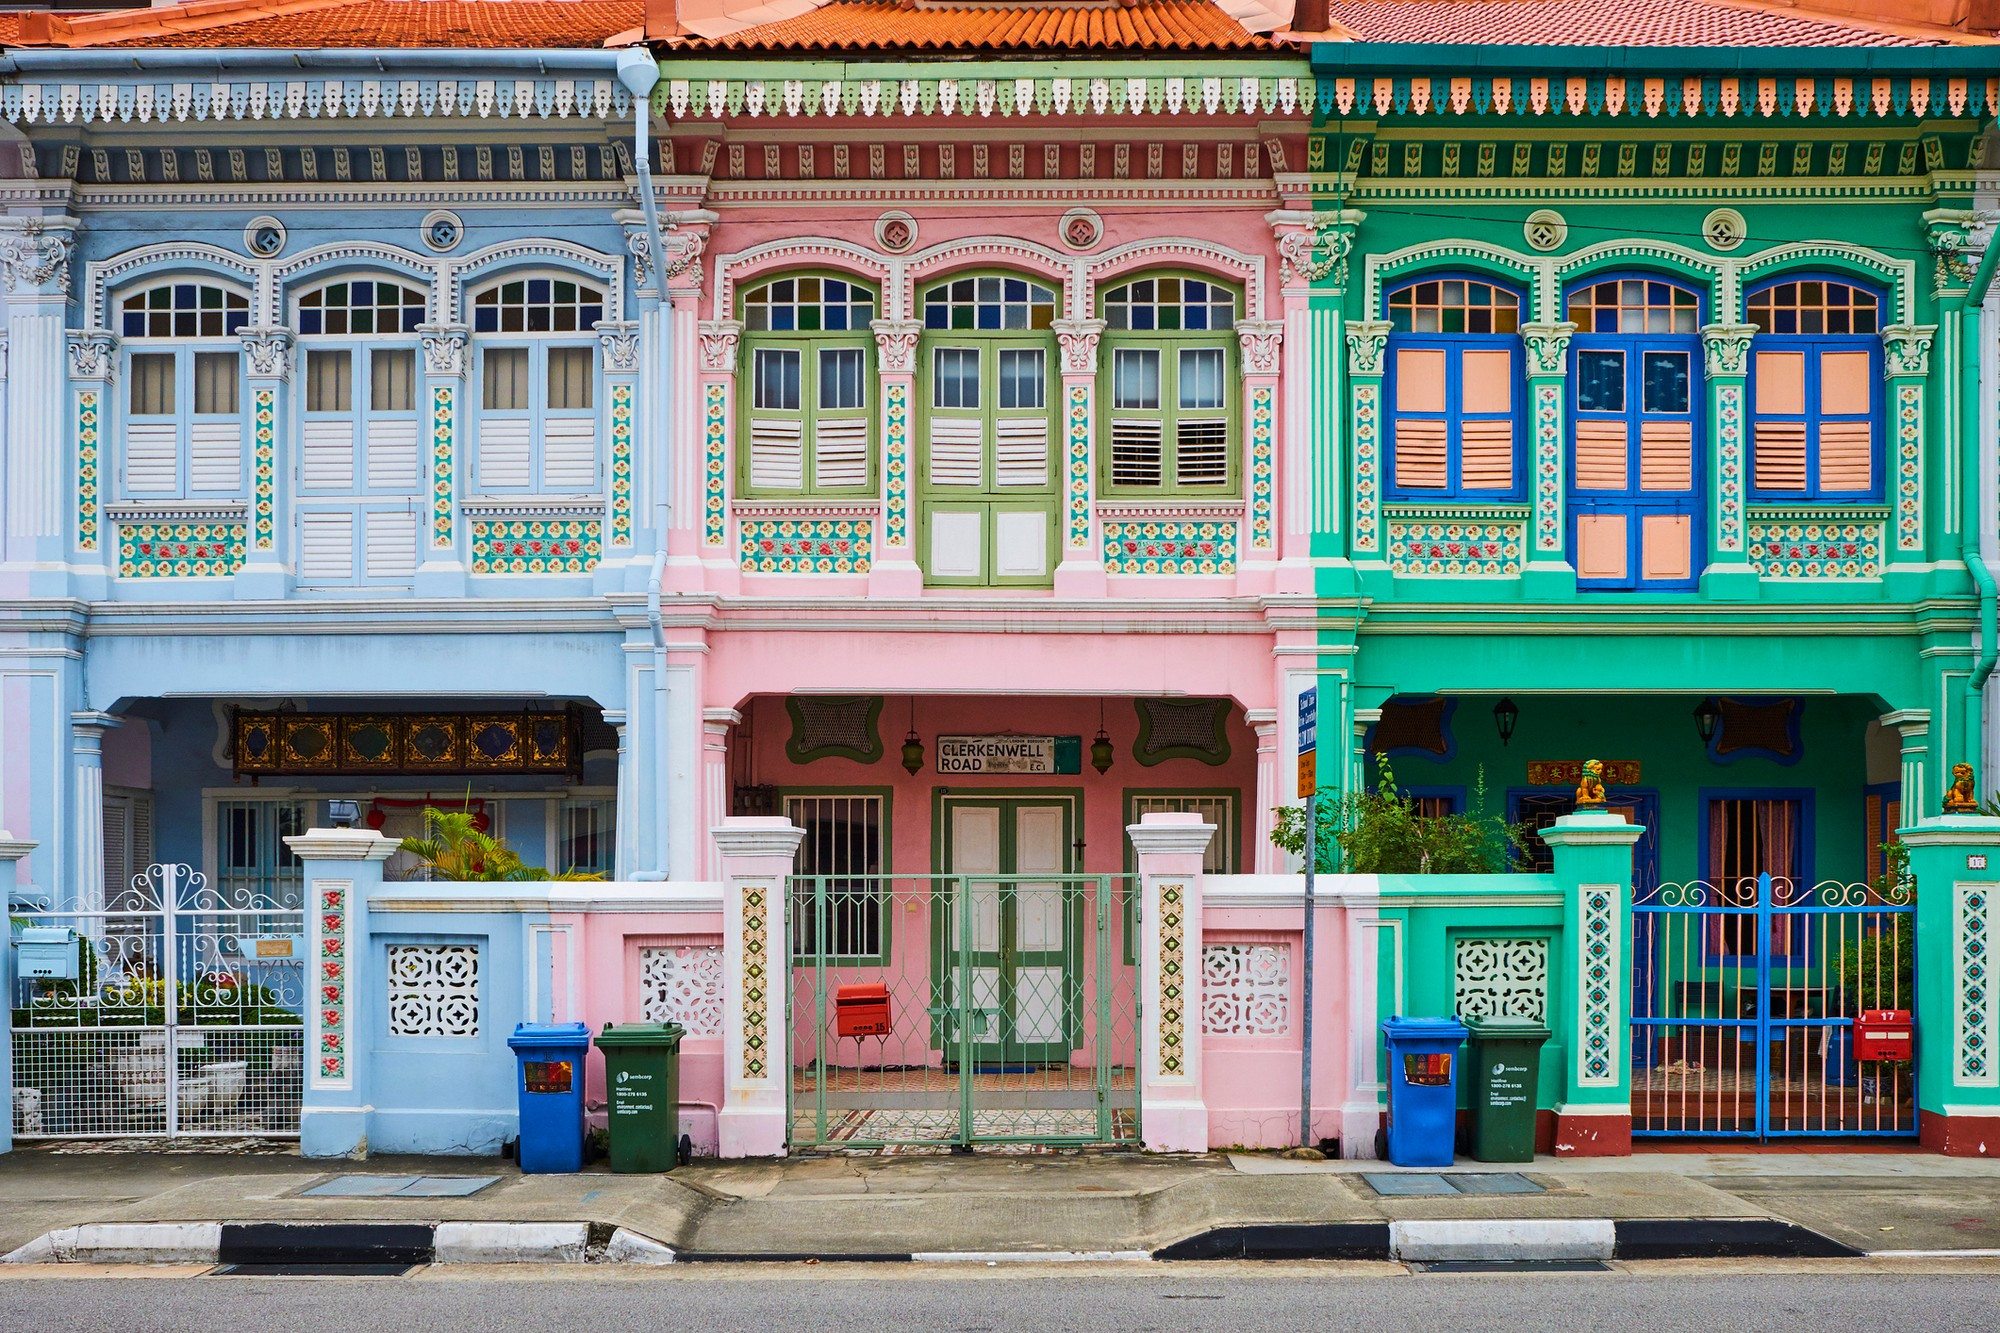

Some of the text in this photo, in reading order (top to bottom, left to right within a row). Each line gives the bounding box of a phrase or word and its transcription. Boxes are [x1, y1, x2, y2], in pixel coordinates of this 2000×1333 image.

[942, 744, 1044, 757] CLERKENWELL
[941, 759, 982, 771] ROAD
[1881, 1012, 1895, 1021] 17
[875, 1022, 886, 1031] 15
